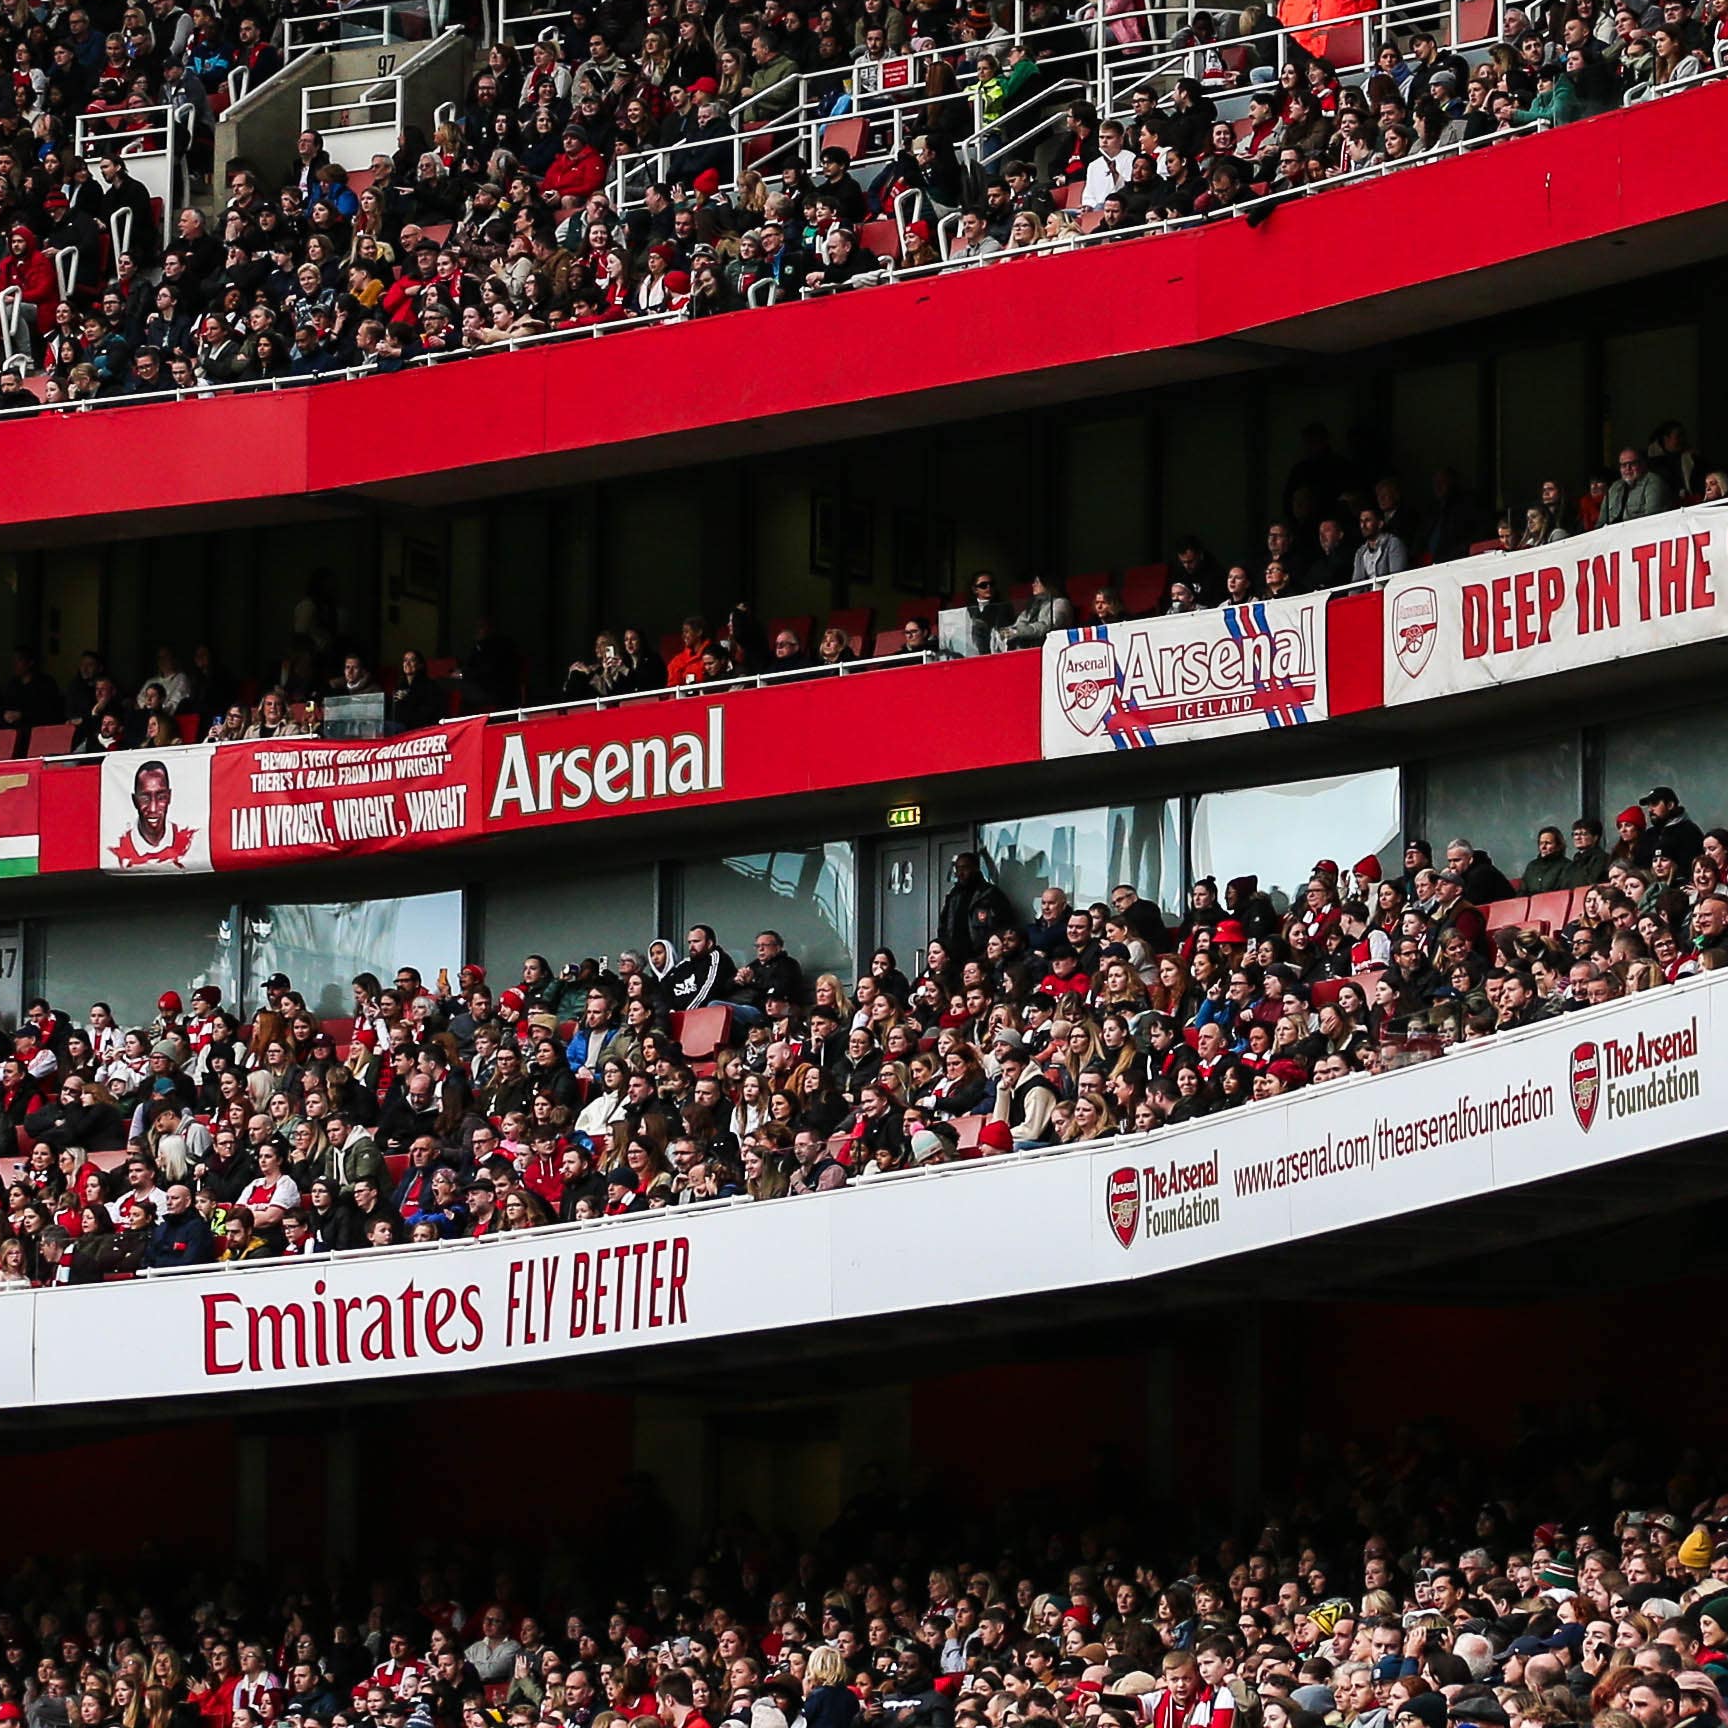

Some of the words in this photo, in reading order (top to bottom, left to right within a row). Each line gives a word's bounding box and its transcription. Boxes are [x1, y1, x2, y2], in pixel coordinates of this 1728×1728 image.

[377, 54, 396, 77] 97
[1462, 566, 1566, 660] DEEP
[1576, 551, 1620, 635] IN
[1632, 531, 1716, 622] THE
[1066, 654, 1108, 673] Arsenal
[1121, 606, 1314, 701] Arsenal
[1176, 695, 1254, 720] ICELAND
[296, 773, 305, 790] A
[306, 770, 336, 788] BALL
[338, 764, 370, 785] FROM
[371, 761, 393, 782] IAN
[301, 749, 338, 768] EVERY
[336, 747, 378, 765] GREAT
[375, 734, 448, 760] GOALKEEPER
[488, 705, 726, 820] Arsenal
[231, 807, 262, 850] IAN
[265, 801, 333, 848] WRIGHT,
[405, 784, 468, 833] WRIGHT
[1603, 1039, 1634, 1080] The
[1635, 1016, 1698, 1072] Arsenal
[1607, 1064, 1700, 1120] Foundation
[1234, 1079, 1554, 1198] www.arsenal.com/thearsenalfoundation
[1143, 1165, 1168, 1203] The
[1168, 1149, 1219, 1197] Arsenal
[1145, 1192, 1220, 1239] Foundation
[201, 1278, 484, 1377] Emirates
[506, 1255, 561, 1348] FLY
[569, 1236, 690, 1340] BETTER
